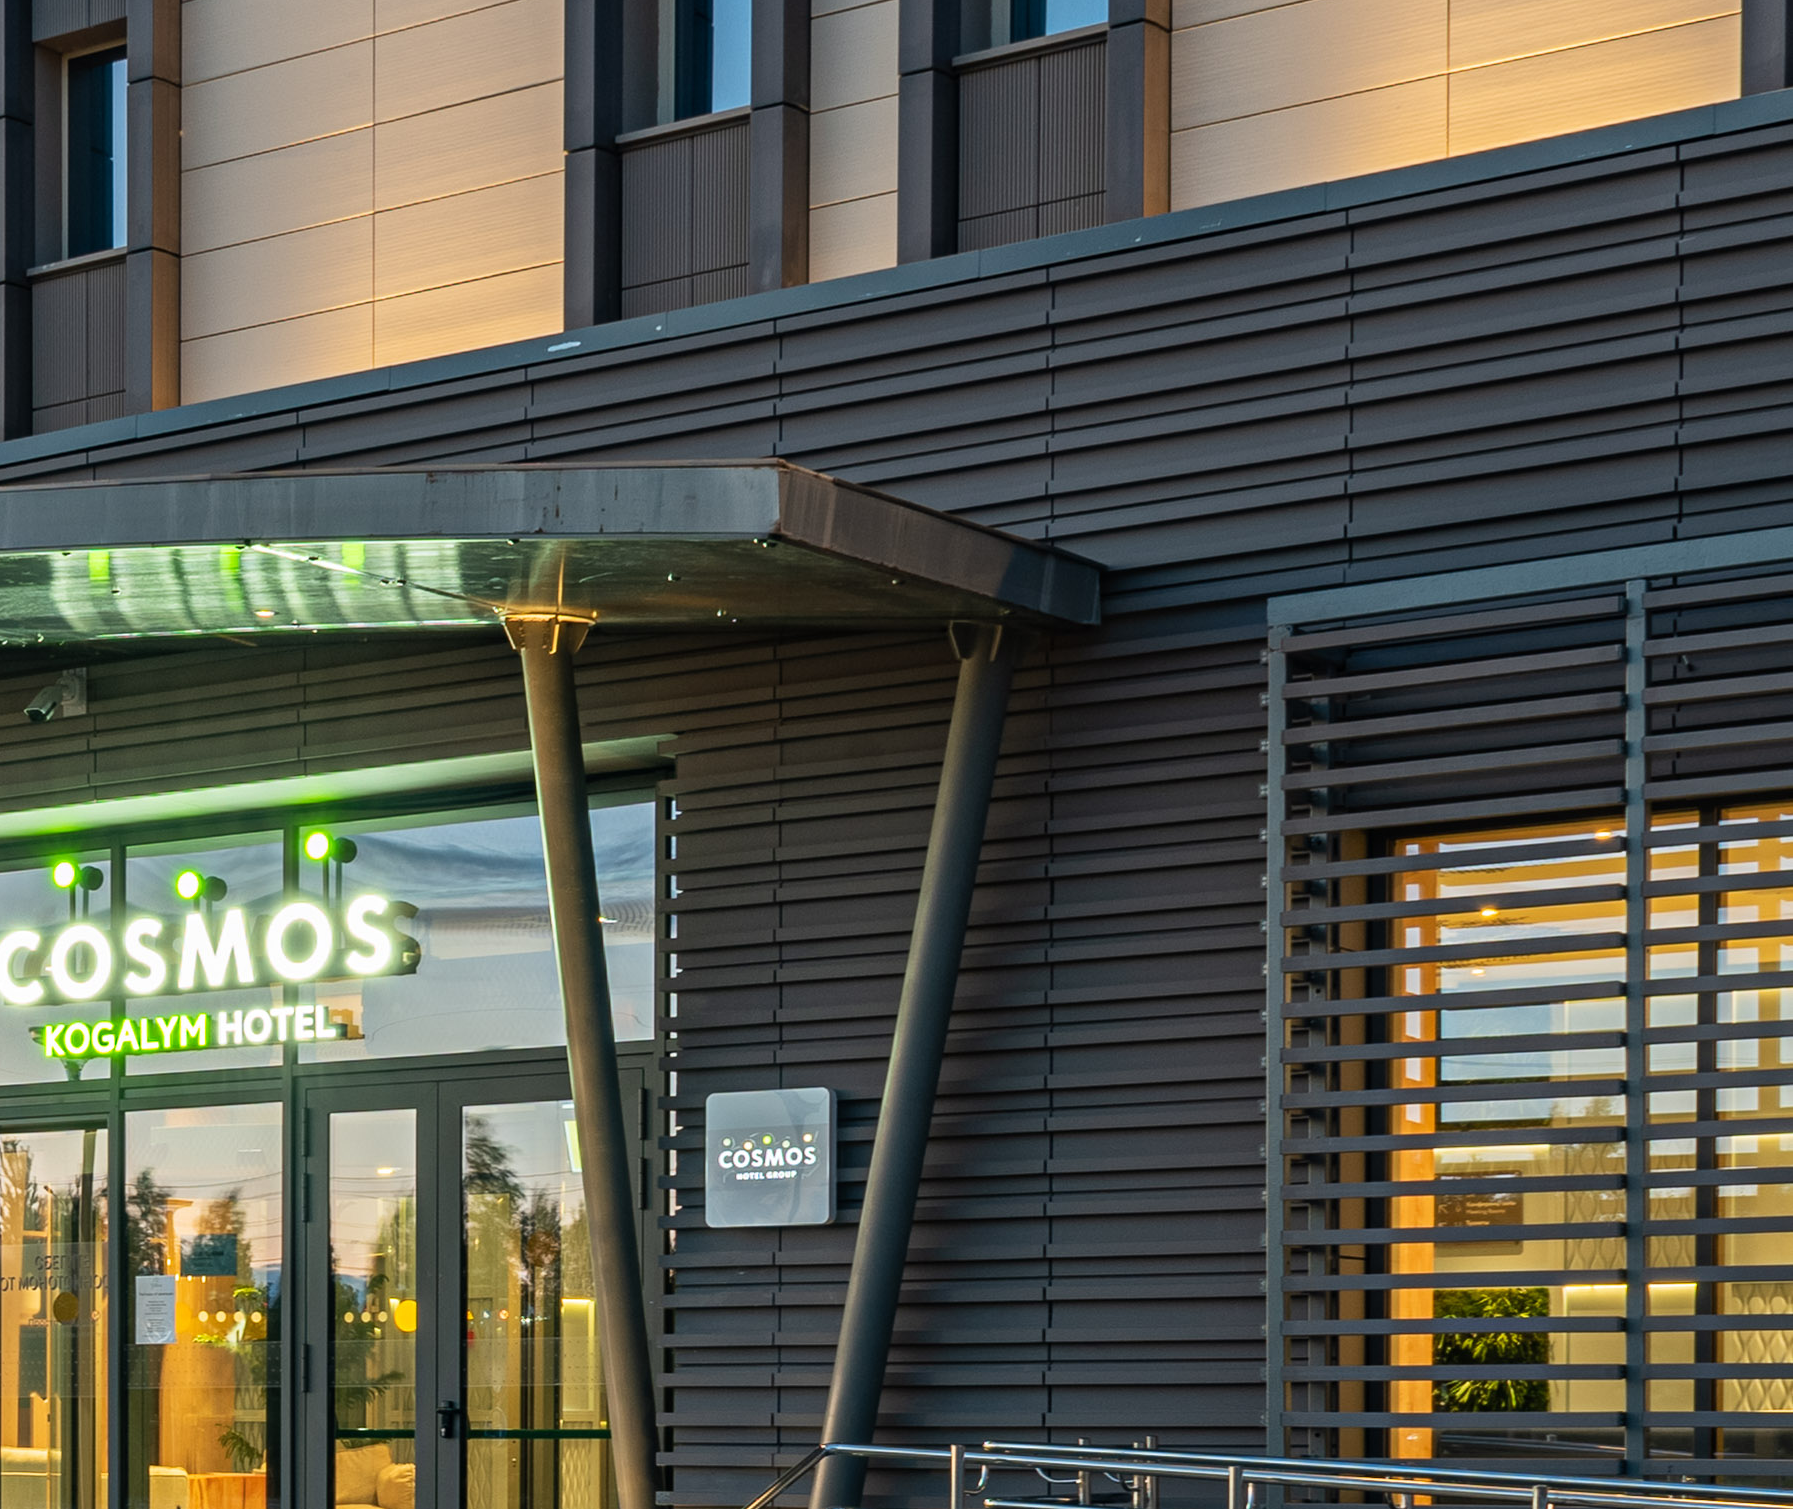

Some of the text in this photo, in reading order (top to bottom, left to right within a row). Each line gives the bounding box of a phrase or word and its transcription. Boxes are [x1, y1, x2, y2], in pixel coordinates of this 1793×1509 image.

[45, 1006, 337, 1057] KOGALYM HOTEL
[718, 1146, 816, 1169] COSMOS
[736, 1170, 797, 1180] HOTEL GROUP
